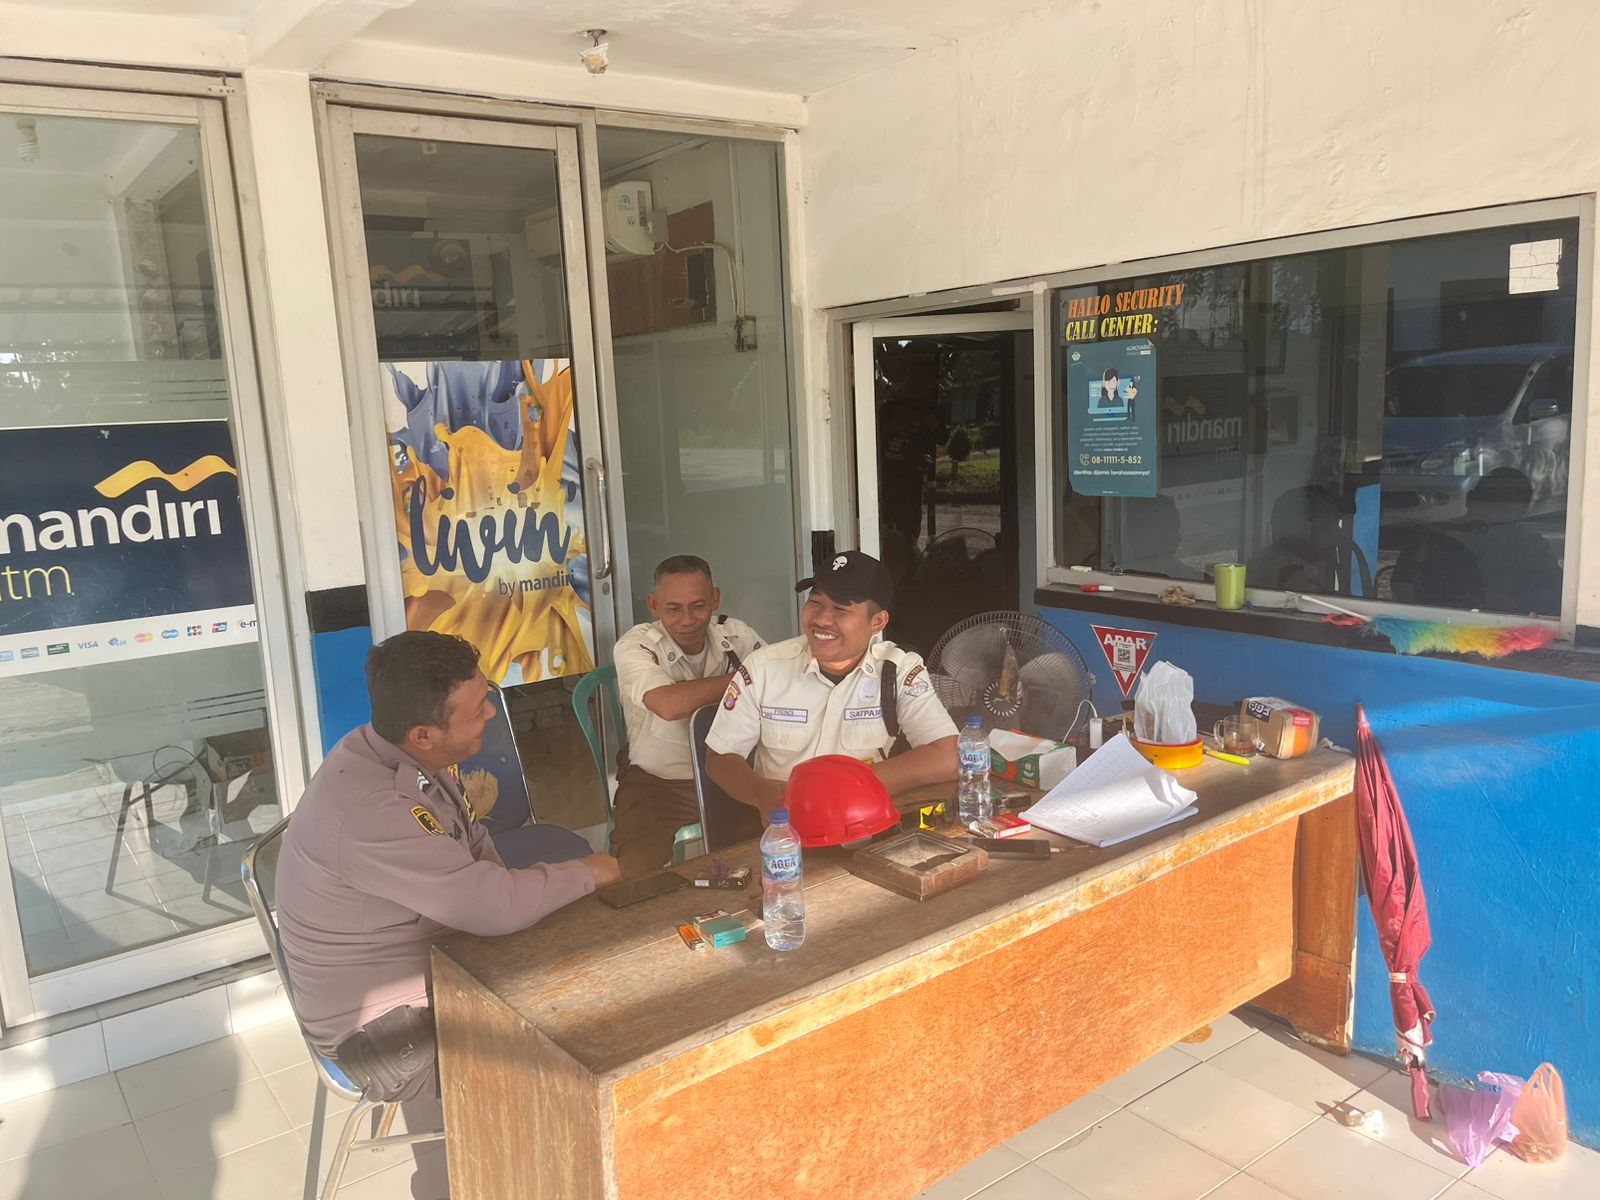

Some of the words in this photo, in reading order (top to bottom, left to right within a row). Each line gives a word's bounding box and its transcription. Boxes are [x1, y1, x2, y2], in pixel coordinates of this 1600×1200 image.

[1068, 294, 1111, 318] HALLO
[1115, 283, 1186, 312] SECURITY
[1065, 319, 1096, 341] CALL
[1100, 313, 1158, 338] CENTER:
[0, 565, 72, 600] tm
[498, 578, 516, 599] by
[519, 569, 576, 592] mandiri
[77, 640, 99, 650] VISA
[849, 708, 882, 719] SATPAM
[962, 752, 984, 764] AQUA
[770, 857, 797, 870] AQUA
